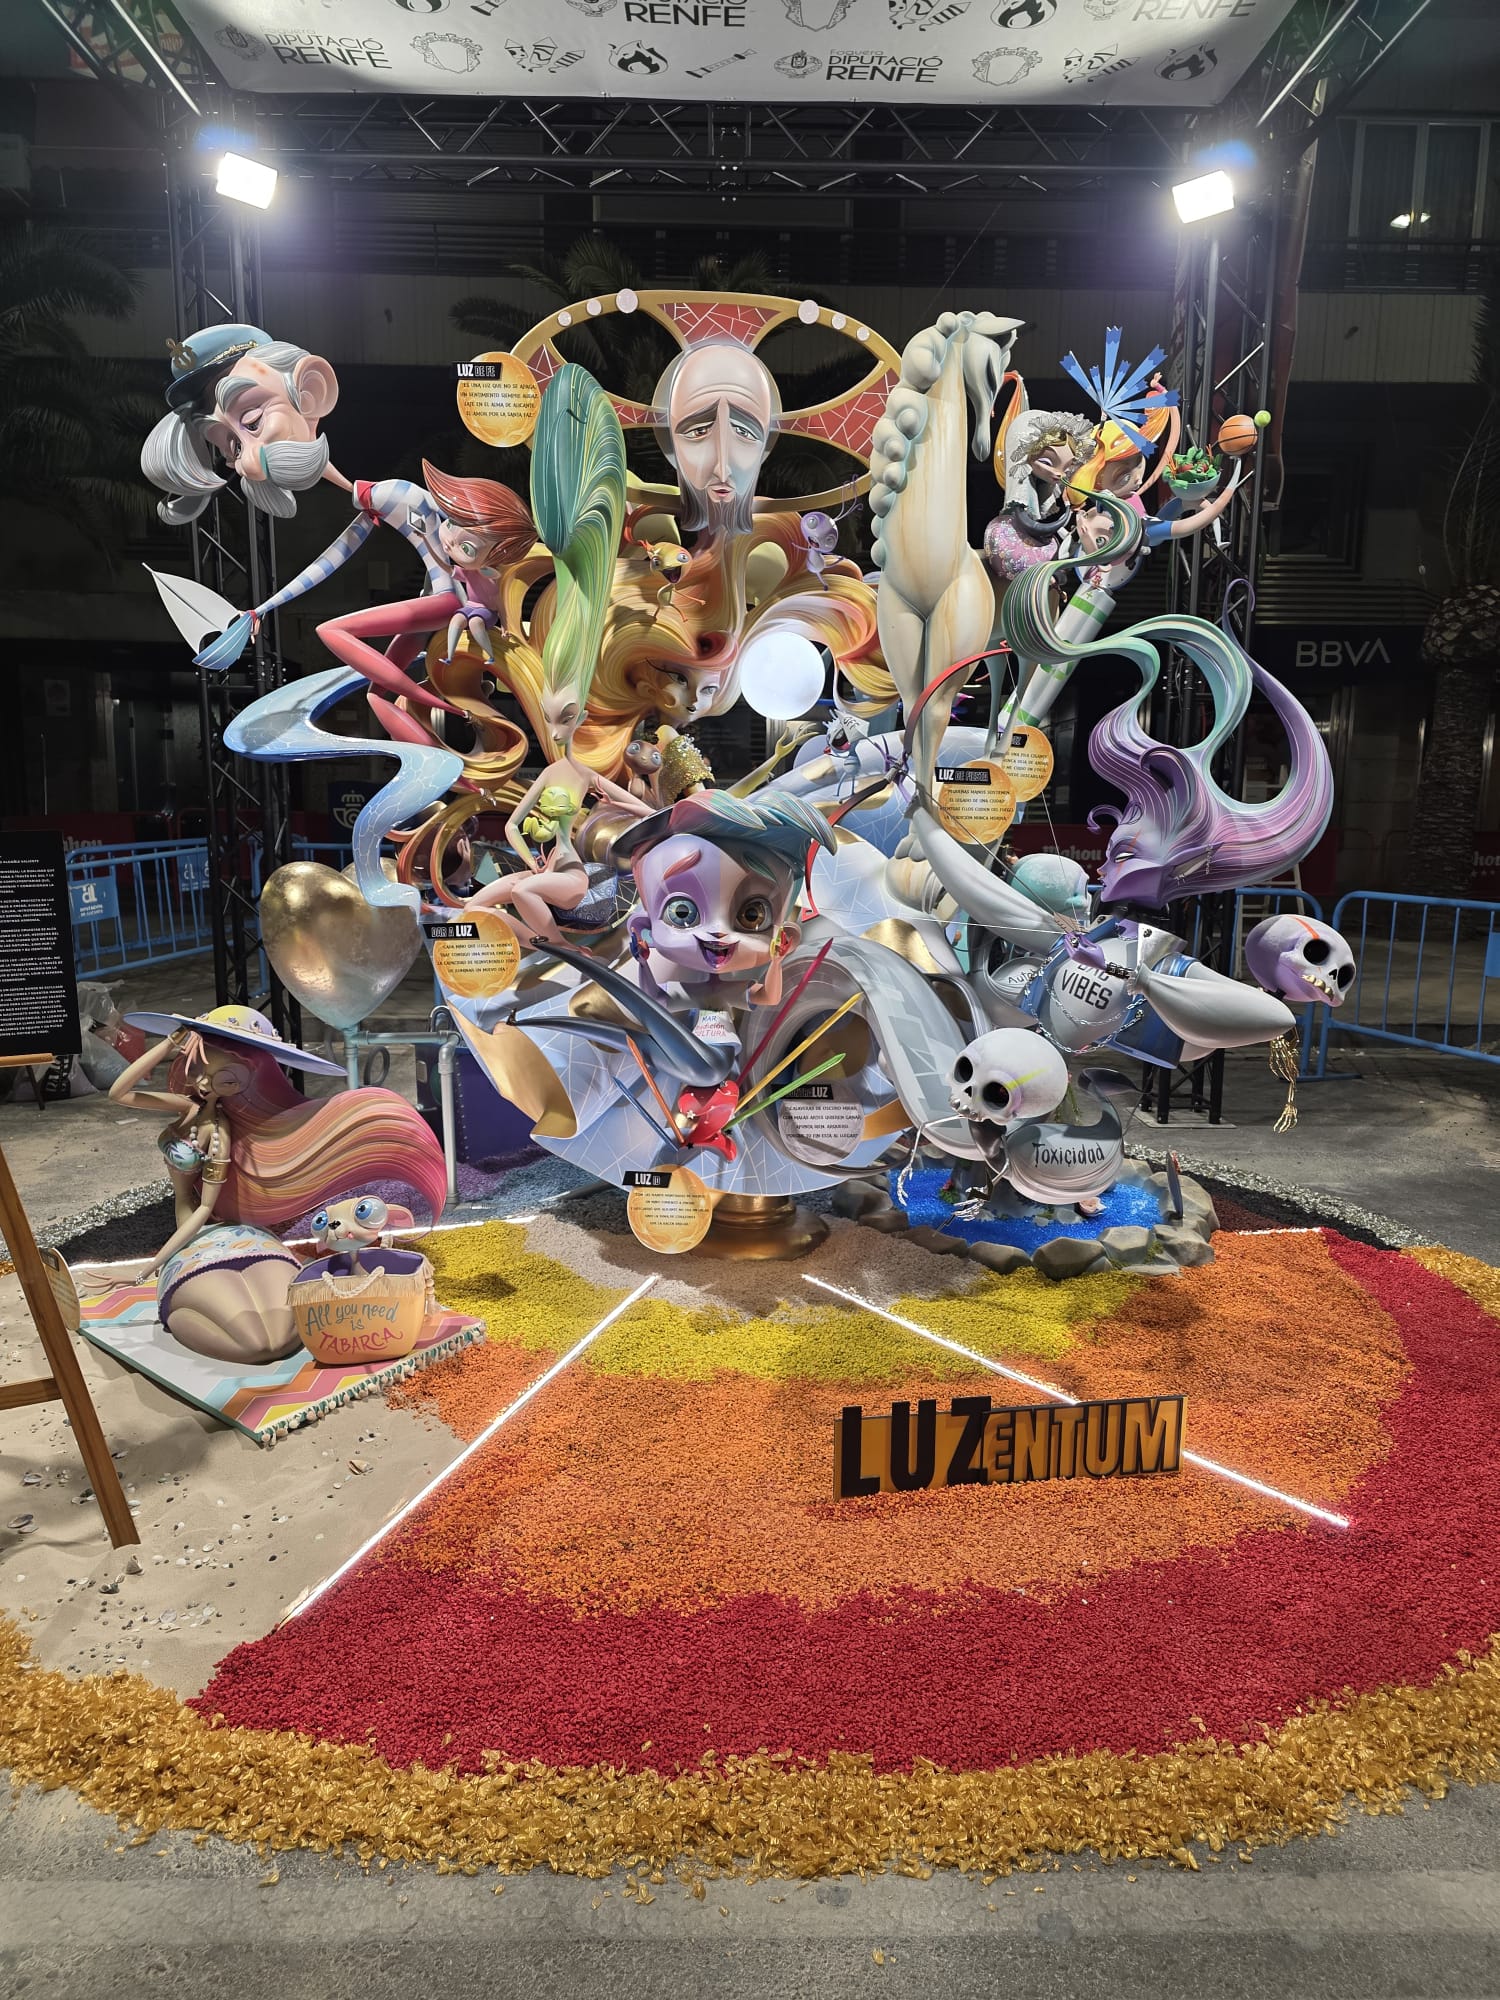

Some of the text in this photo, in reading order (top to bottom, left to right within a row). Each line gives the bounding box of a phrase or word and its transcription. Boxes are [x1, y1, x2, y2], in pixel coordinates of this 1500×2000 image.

[624, 2, 745, 27] RENFE
[264, 33, 383, 51] DIPUTACIÓ
[273, 46, 392, 69] RENFE
[829, 55, 943, 67] DIPUTACIÓ
[826, 65, 940, 82] RENFE
[457, 364, 474, 377] LUZ
[475, 366, 485, 376] DE
[1296, 638, 1390, 667] BBVA
[456, 925, 472, 937] LUZ
[1062, 970, 1112, 1010] VIBES
[812, 1086, 828, 1098] LUZ
[1032, 1142, 1104, 1168] Toxicidad
[635, 1172, 652, 1185] LUZ
[306, 1302, 399, 1336] All you need
[351, 1316, 364, 1330] is
[319, 1327, 403, 1355] TABARCA
